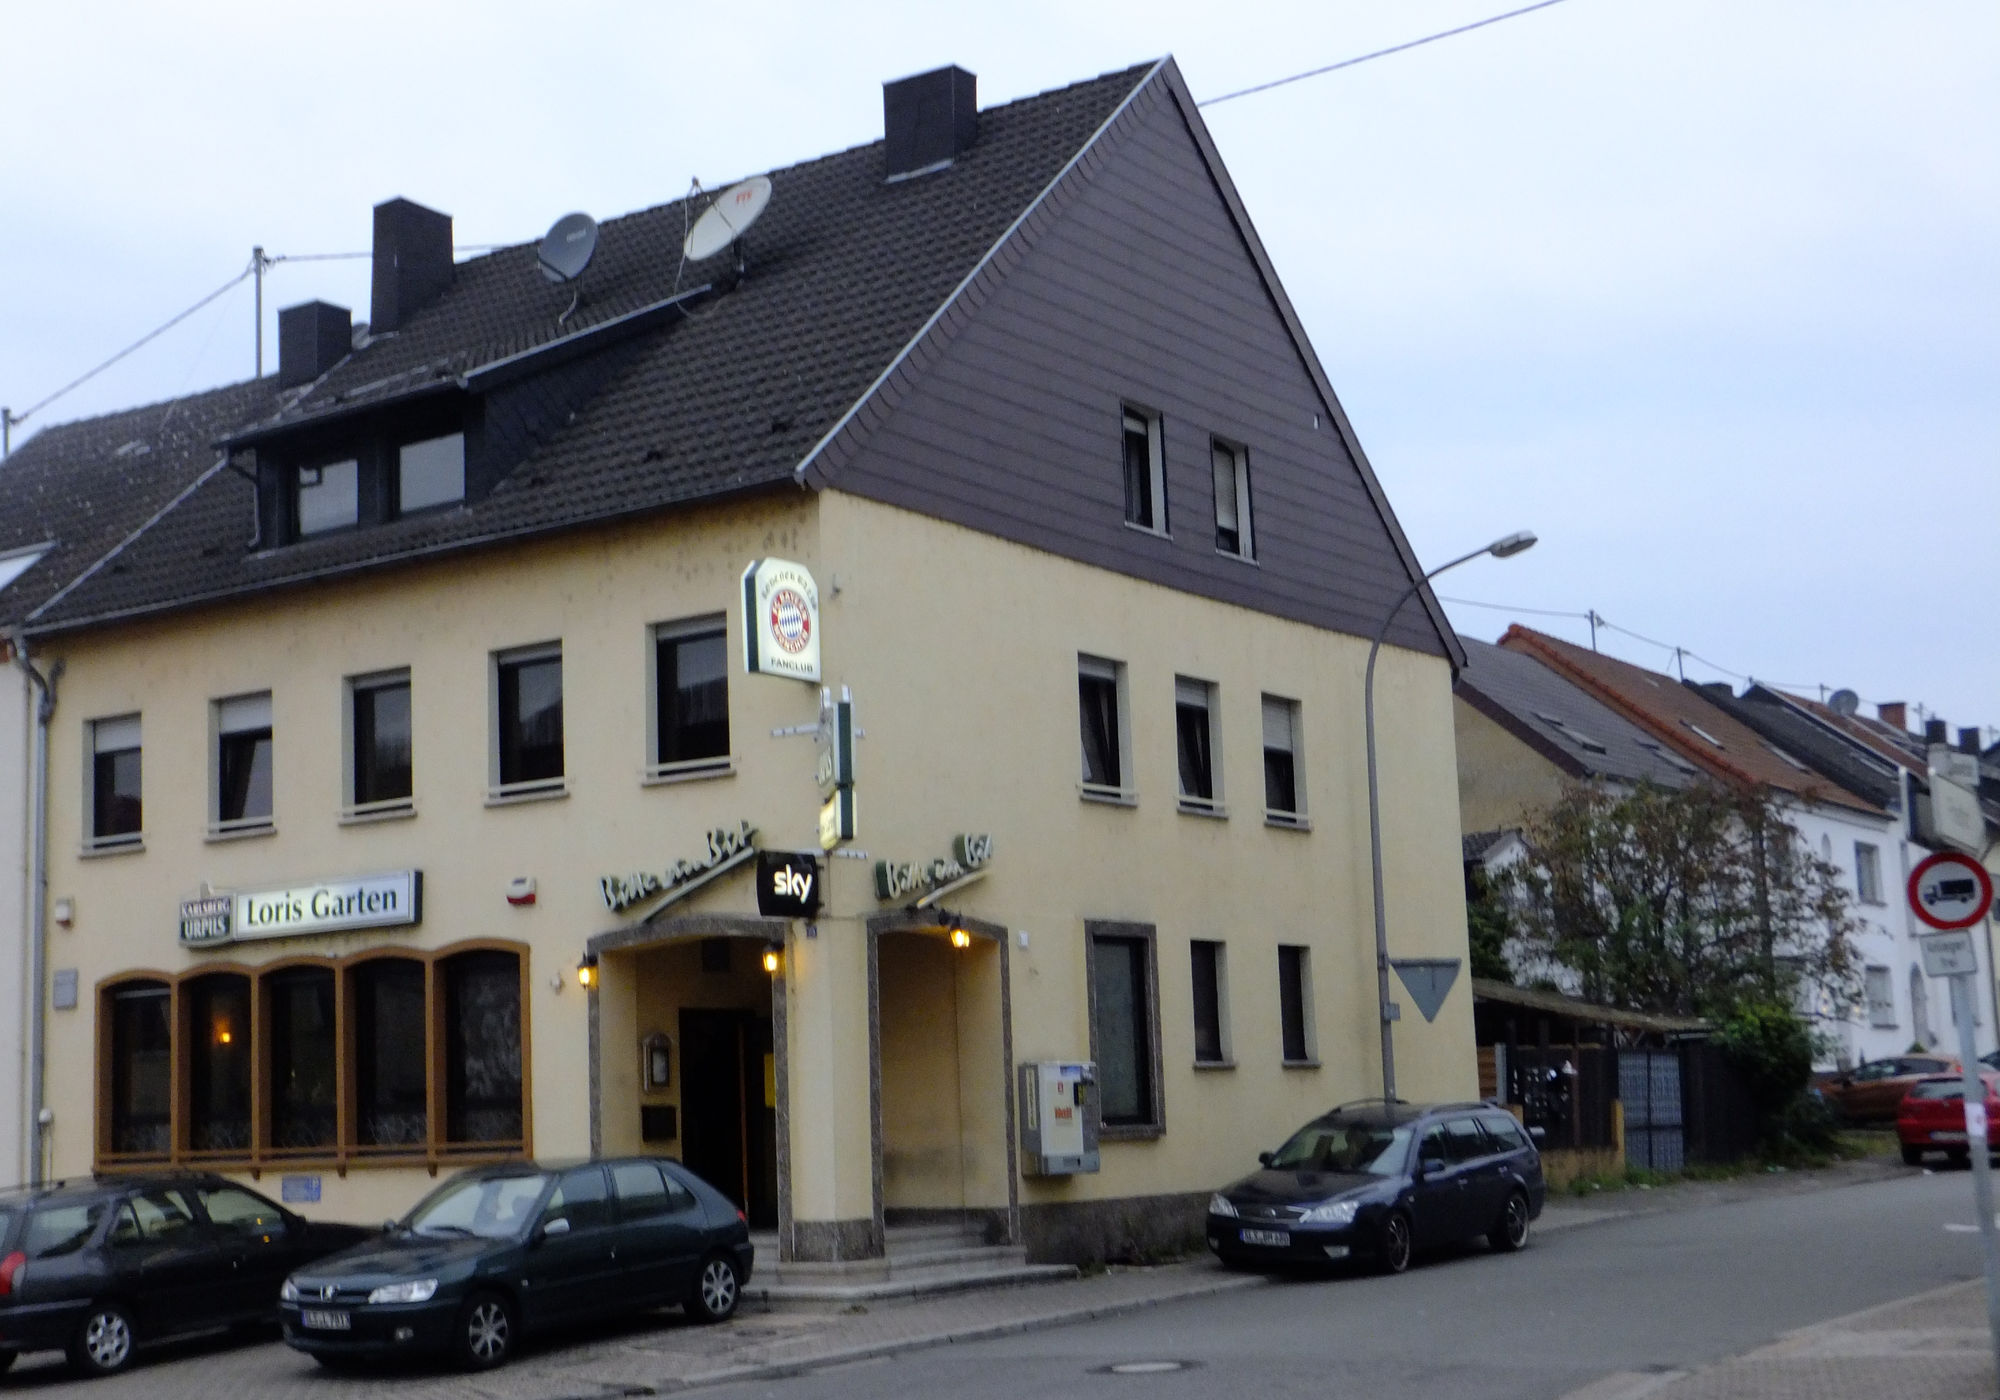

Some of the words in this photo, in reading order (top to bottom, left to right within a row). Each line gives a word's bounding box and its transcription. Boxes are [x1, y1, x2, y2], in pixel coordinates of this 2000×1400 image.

[771, 656, 814, 673] FANCLUB
[773, 863, 813, 904] sky
[247, 890, 303, 926] Loris
[311, 887, 397, 919] Garten
[184, 916, 227, 939] URPILS
